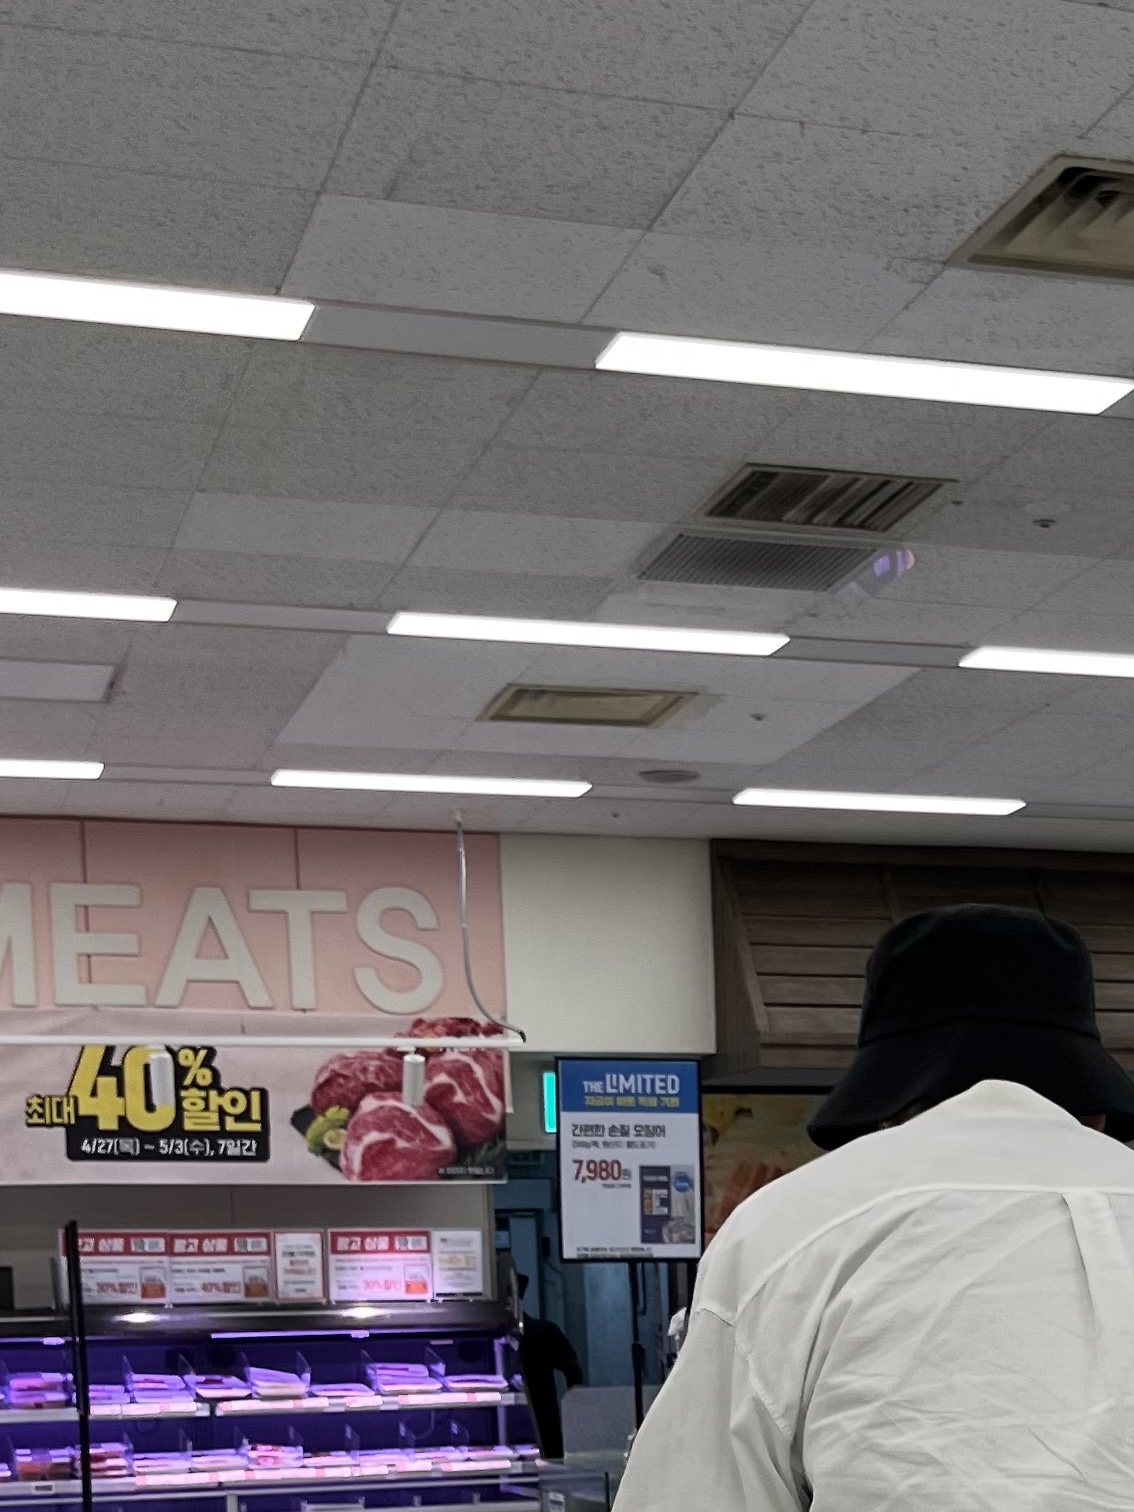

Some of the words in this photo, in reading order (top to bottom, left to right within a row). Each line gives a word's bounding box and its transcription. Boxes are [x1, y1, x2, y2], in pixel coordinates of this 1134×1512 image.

[606, 1073, 680, 1094] LIMITED
[26, 1096, 76, 1126] 최대
[180, 1088, 262, 1132] 할인
